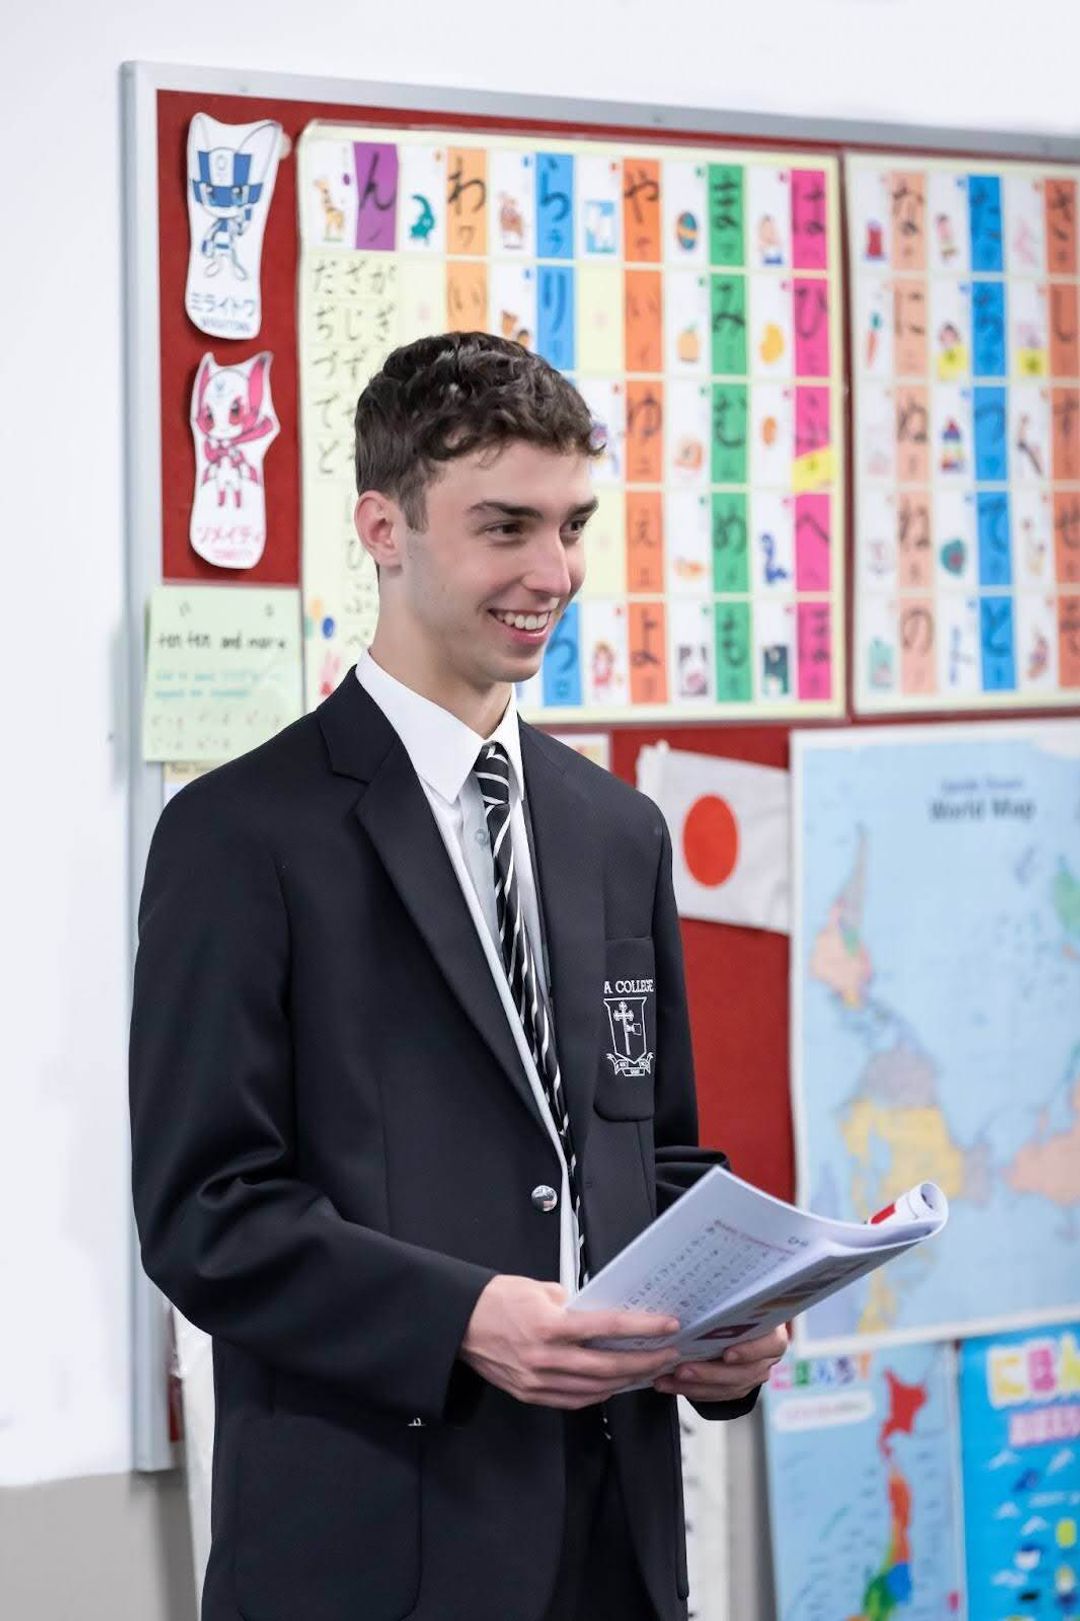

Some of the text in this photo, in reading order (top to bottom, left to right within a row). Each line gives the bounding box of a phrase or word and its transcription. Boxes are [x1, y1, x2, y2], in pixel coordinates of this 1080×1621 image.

[359, 152, 397, 211] ん
[447, 156, 488, 216] わ
[539, 157, 571, 222] ら
[623, 169, 661, 225] や
[713, 171, 739, 231] ま
[892, 178, 925, 236] な
[791, 180, 825, 237] は
[314, 258, 397, 296] だ ざ が
[543, 273, 567, 333] り
[315, 302, 396, 342] ぢ じ ぎ
[712, 282, 747, 334] み
[796, 286, 829, 340] ひ
[893, 285, 925, 336] に
[313, 391, 341, 429] で
[626, 386, 662, 438] ゆ
[714, 390, 748, 447] む
[318, 438, 339, 474] ど
[635, 508, 655, 546] え
[712, 503, 748, 551] め
[796, 511, 830, 543] へ
[978, 501, 1008, 553] て
[221, 629, 242, 649] and
[632, 610, 659, 667] よ
[720, 609, 747, 668] も
[797, 607, 829, 664] ほ
[901, 608, 934, 654] の
[980, 600, 1010, 657] と
[929, 799, 1035, 821] World Map
[603, 979, 655, 994] A COLLEGE
